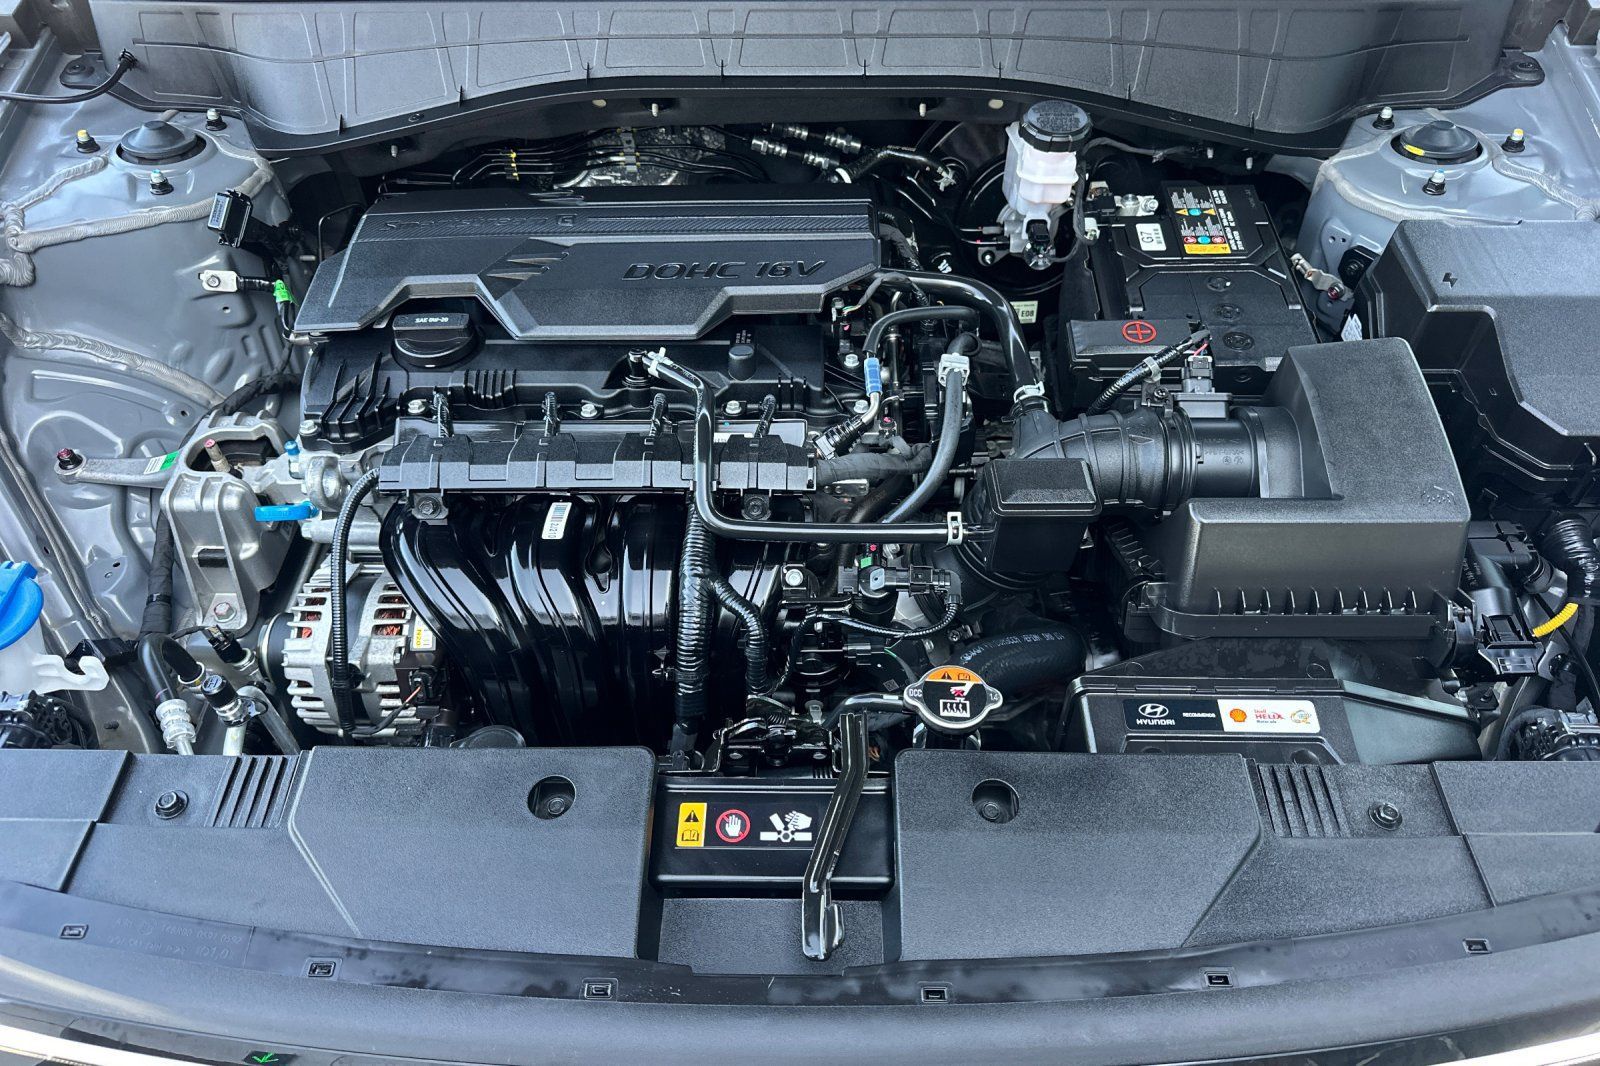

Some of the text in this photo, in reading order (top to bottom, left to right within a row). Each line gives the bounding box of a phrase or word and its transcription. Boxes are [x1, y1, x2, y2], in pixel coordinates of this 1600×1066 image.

[1141, 231, 1154, 244] G7
[621, 260, 827, 281] DOHC 16V
[1136, 718, 1176, 726] HYUNDAI
